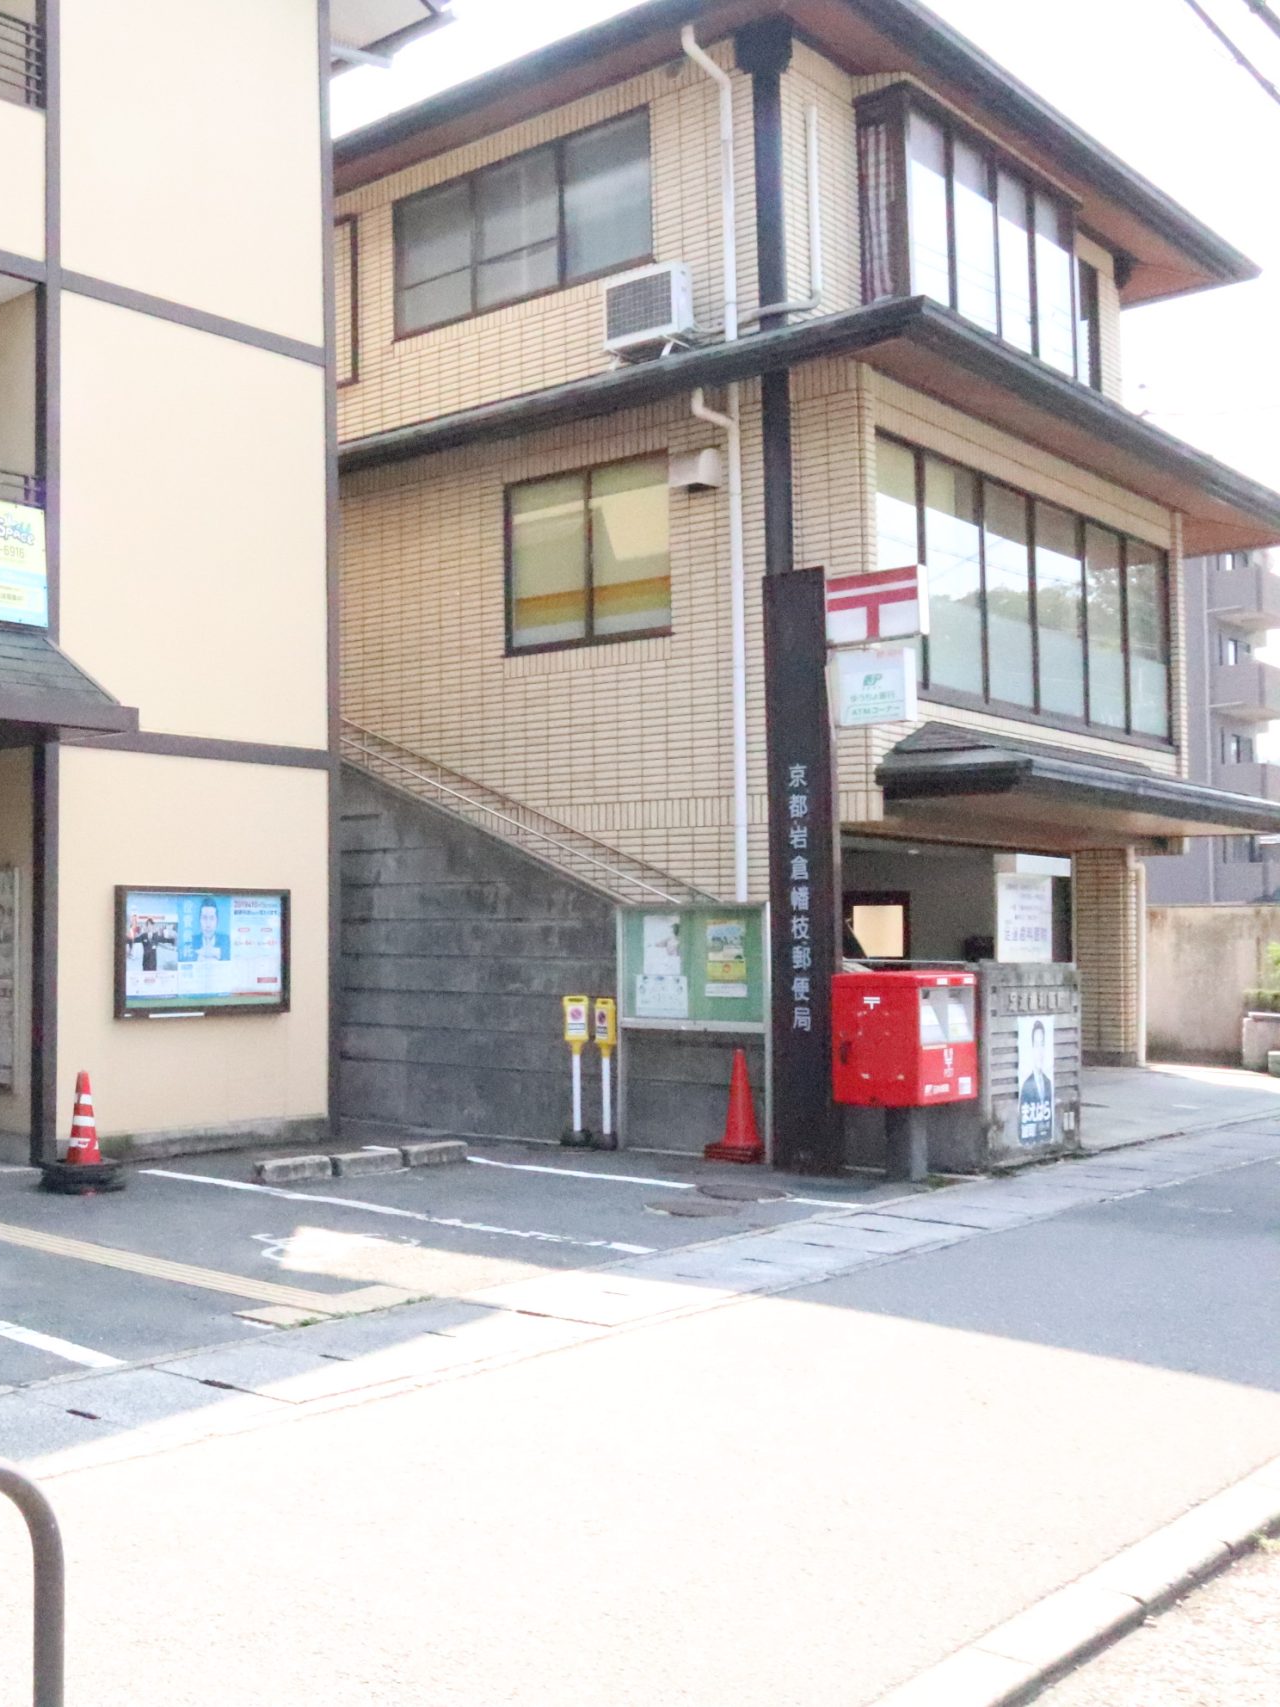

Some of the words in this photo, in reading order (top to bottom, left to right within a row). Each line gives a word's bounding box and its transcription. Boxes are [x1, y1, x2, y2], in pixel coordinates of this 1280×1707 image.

[788, 763, 811, 1032] 京都岩倉幡枝郵便局
[1020, 1101, 1051, 1123] まえはら
